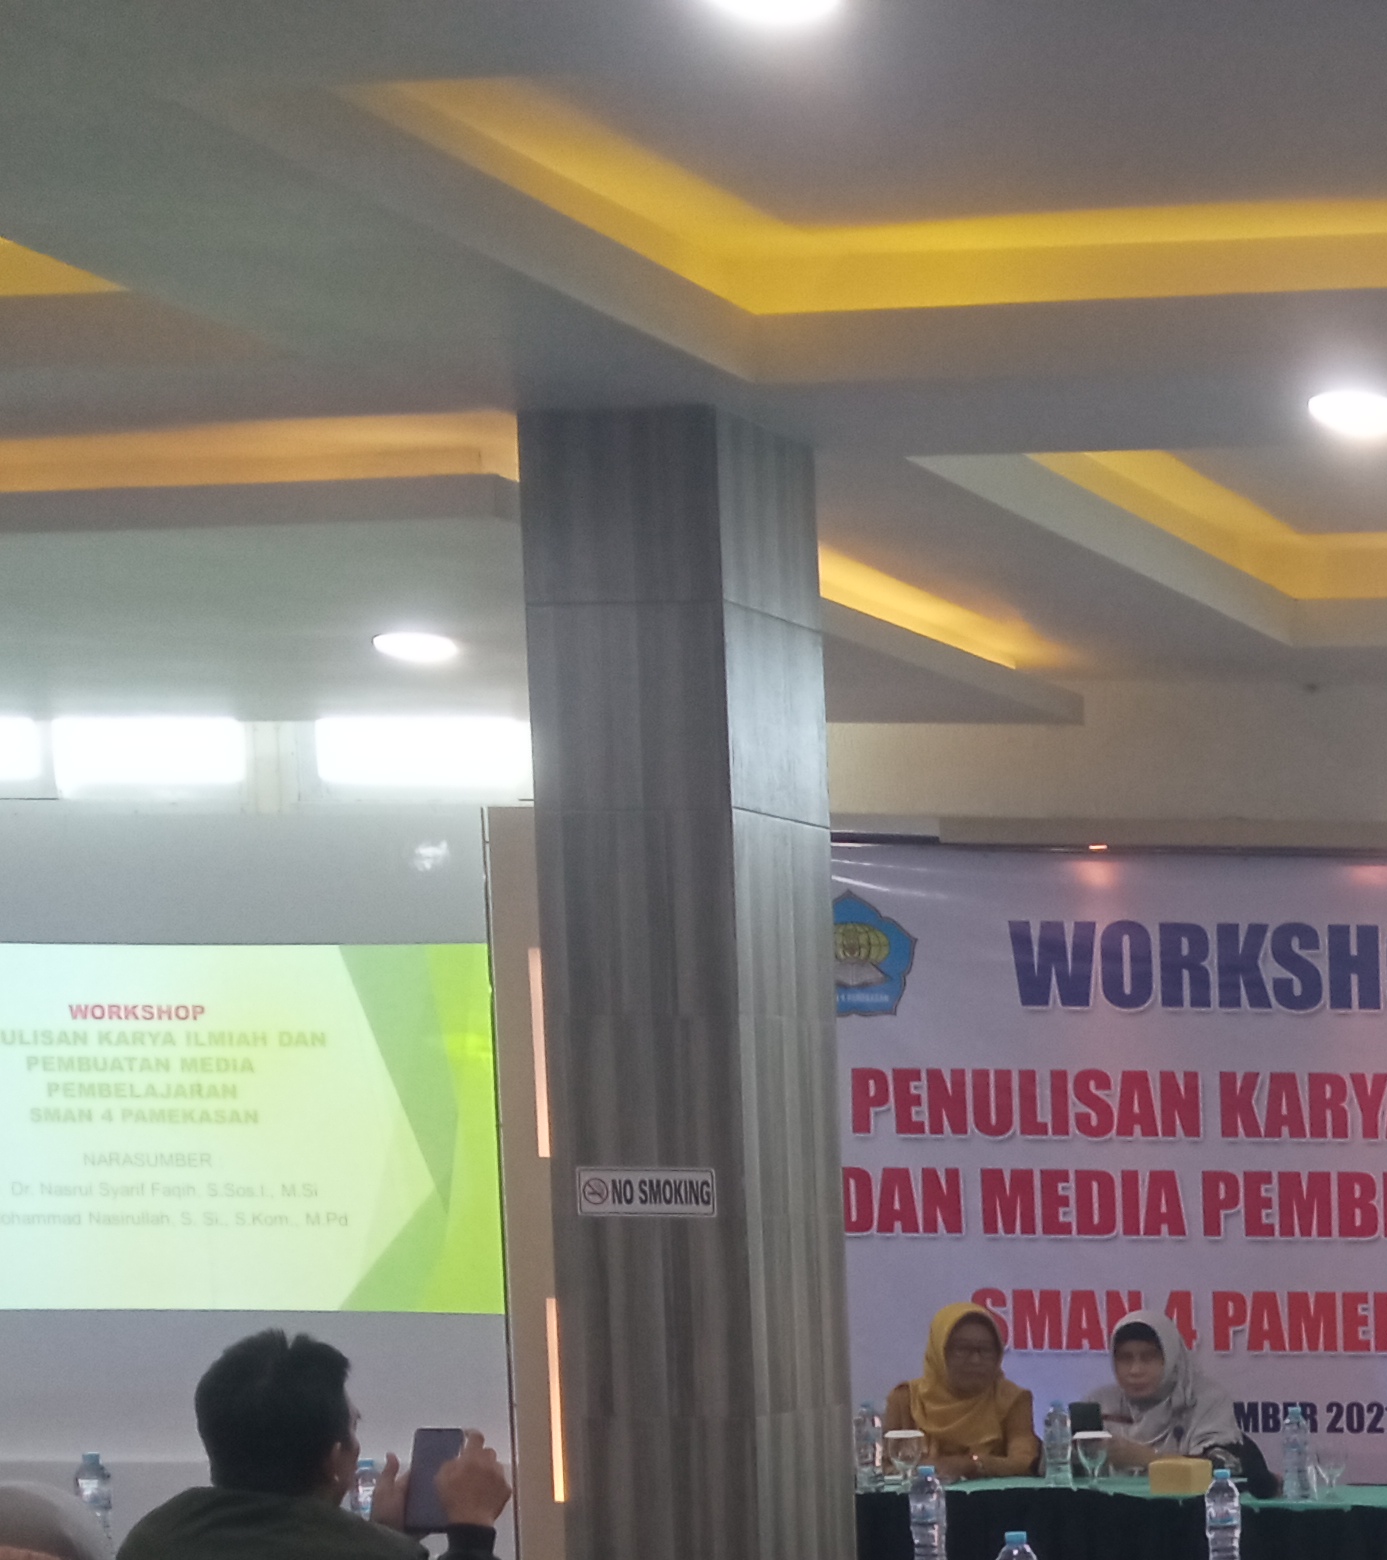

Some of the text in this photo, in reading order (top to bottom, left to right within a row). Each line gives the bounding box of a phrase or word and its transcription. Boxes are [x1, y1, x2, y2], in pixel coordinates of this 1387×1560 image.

[68, 1004, 206, 1021] WORKSHOP
[97, 1030, 177, 1047] KARYA
[185, 1031, 268, 1047] ILMIAH
[278, 1031, 327, 1048] DAN
[26, 1056, 255, 1073] PEMBUATAN MEDIA
[47, 1082, 238, 1099] PEMBELAJARAN
[851, 1067, 1201, 1138] PENULISAN
[30, 1107, 259, 1124] SMAN 4 PAMEKASAN
[83, 1152, 212, 1168] NARASUMBER
[611, 1179, 712, 1206] NO SMOKING
[842, 1167, 963, 1235] DAN
[980, 1168, 1189, 1237] MEDIA
[0, 1211, 82, 1226] ohammad
